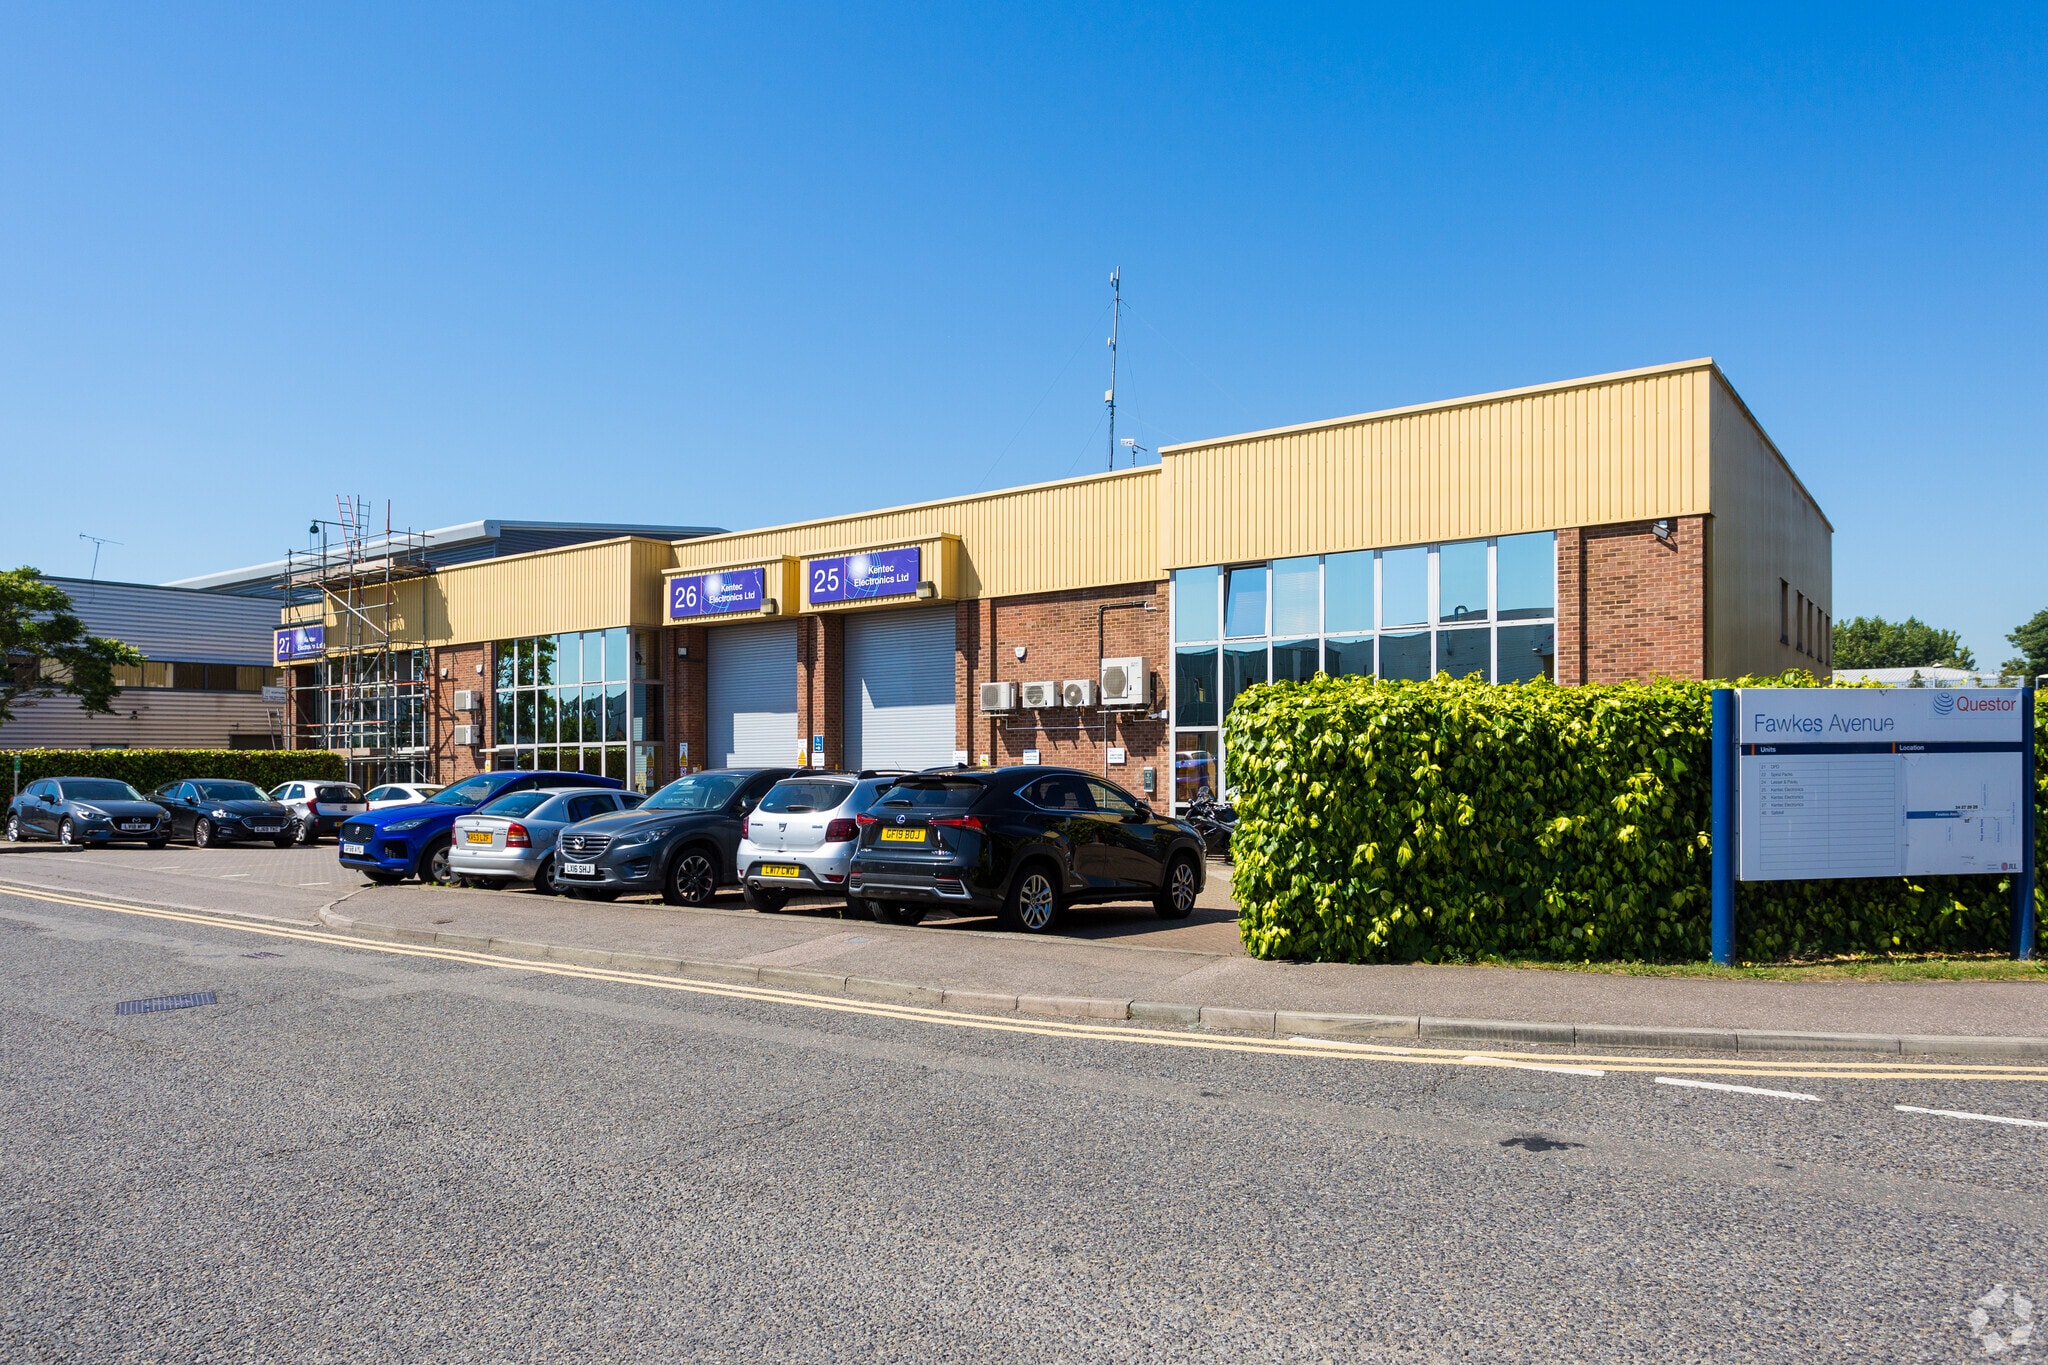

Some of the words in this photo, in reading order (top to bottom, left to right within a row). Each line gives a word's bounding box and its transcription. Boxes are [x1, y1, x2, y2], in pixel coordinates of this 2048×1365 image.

[868, 564, 895, 575] Kentec
[813, 568, 839, 592] 25
[854, 574, 895, 587] Electronics
[896, 572, 909, 583] Ltd
[720, 582, 743, 593] Kentec
[674, 585, 697, 608] 26
[709, 592, 743, 604] Electronics
[744, 591, 755, 601] Ltd
[279, 637, 290, 653] 27
[1956, 696, 2017, 712] Questor
[1754, 713, 1823, 732] Fawkes
[1828, 713, 1895, 732] Avenue
[1760, 745, 1776, 753] Units
[886, 829, 903, 839] GF19
[566, 864, 578, 873] LX16
[579, 865, 591, 874] SHJ
